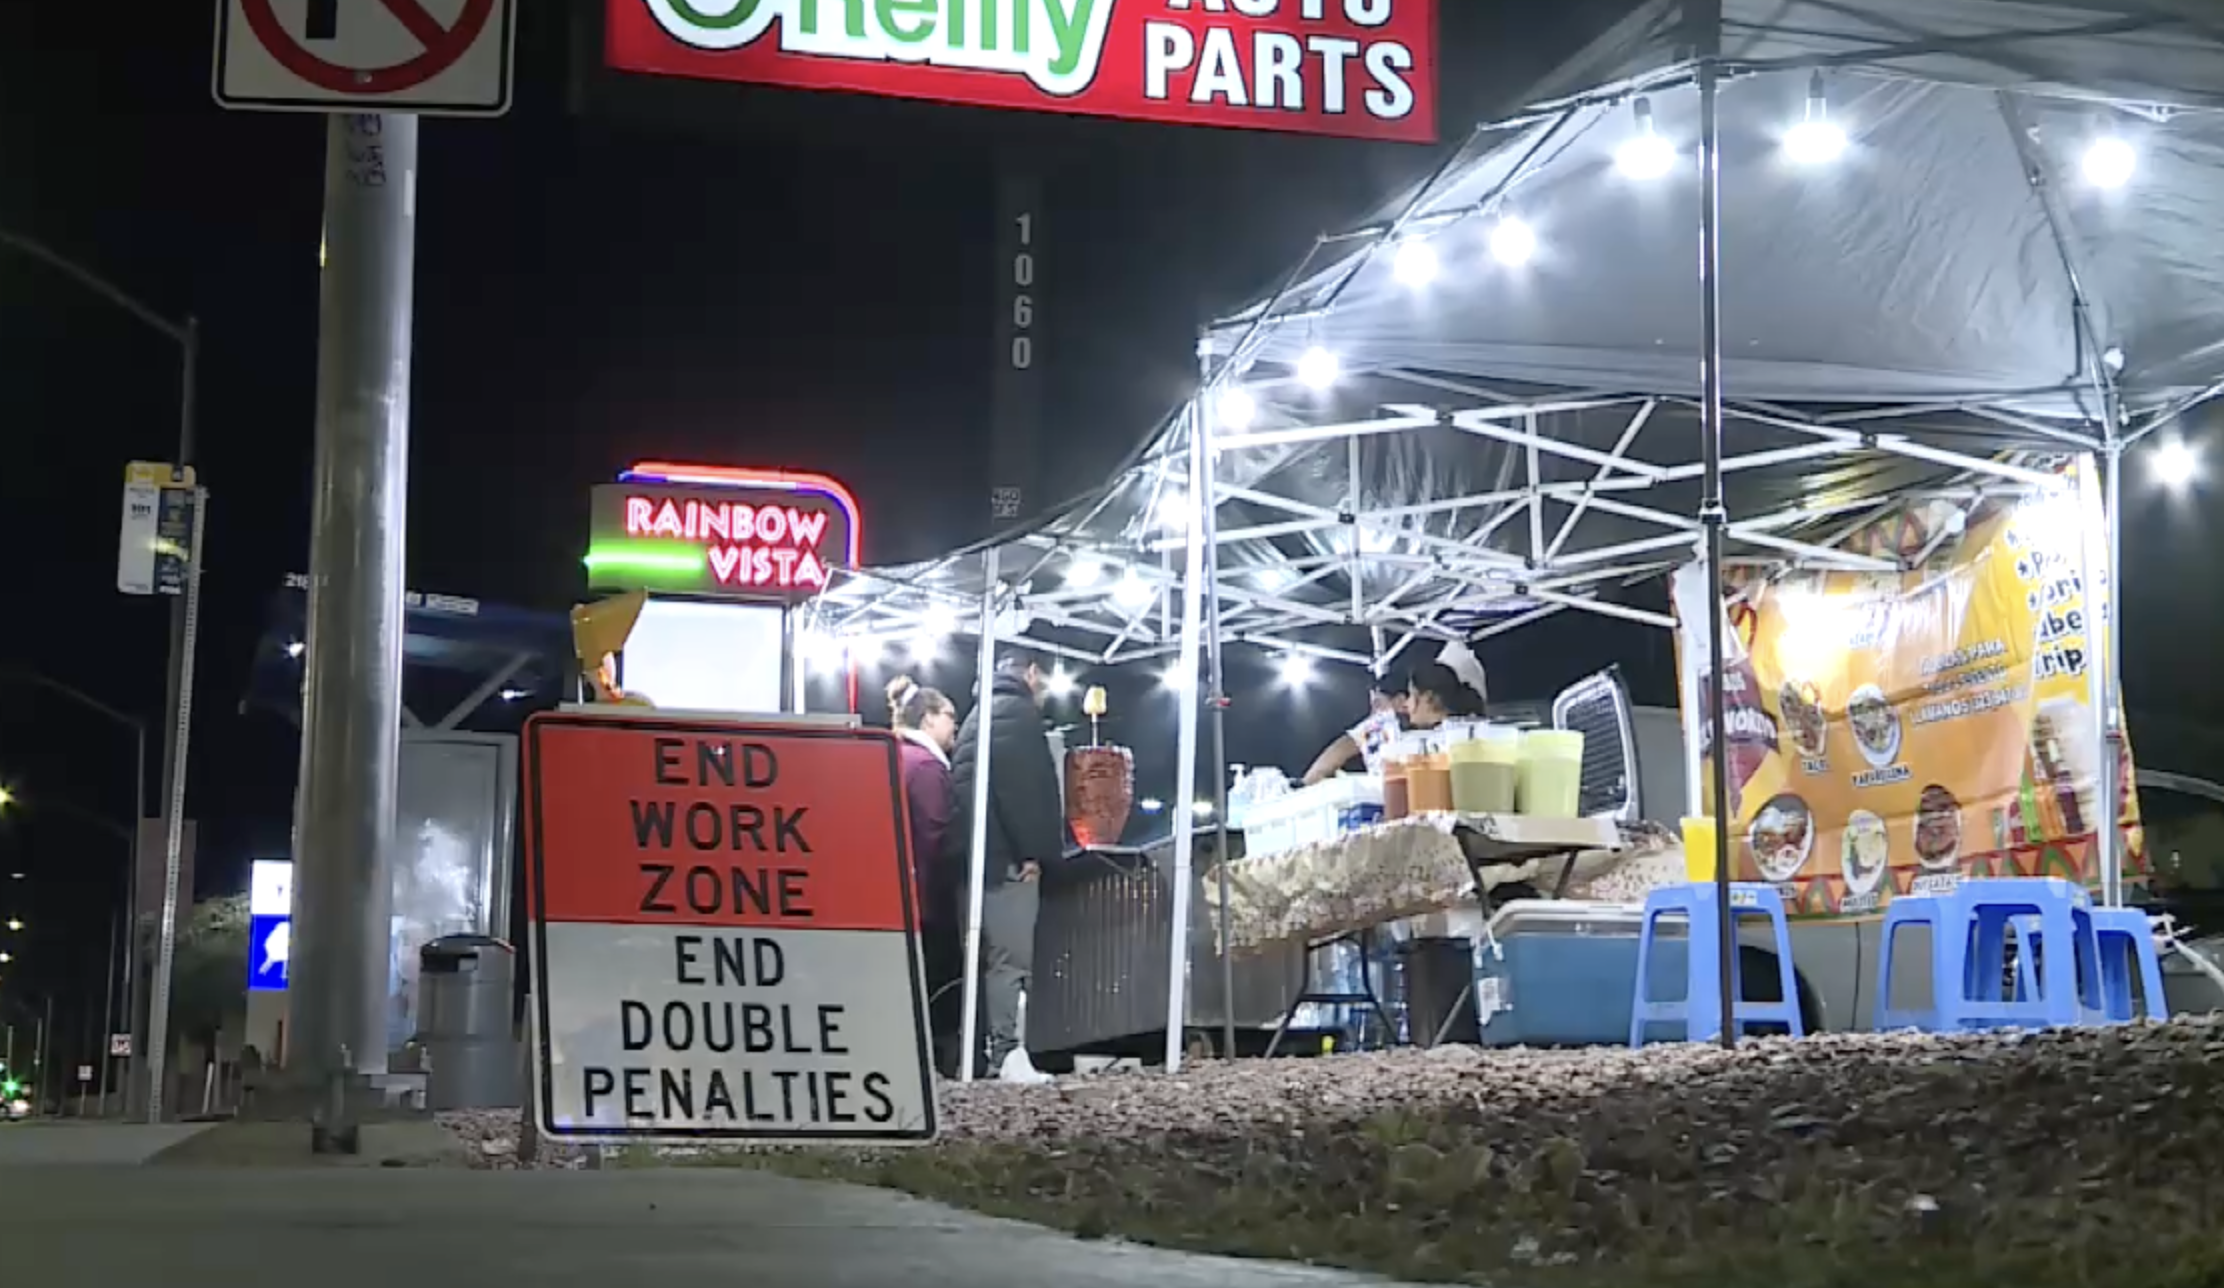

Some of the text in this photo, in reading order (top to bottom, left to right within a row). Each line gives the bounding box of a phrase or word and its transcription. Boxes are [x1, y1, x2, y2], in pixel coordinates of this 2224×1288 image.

[1144, 20, 1415, 120] PARTS
[1011, 212, 1034, 370] 1060
[624, 496, 828, 548] RAINBOW
[707, 546, 826, 587] VISTA
[654, 738, 779, 788] END
[631, 800, 813, 853] WORK
[640, 864, 814, 917] ZONE
[675, 936, 785, 987] END
[621, 1000, 849, 1054] DOUBLE
[583, 1067, 894, 1123] PENALTIES
